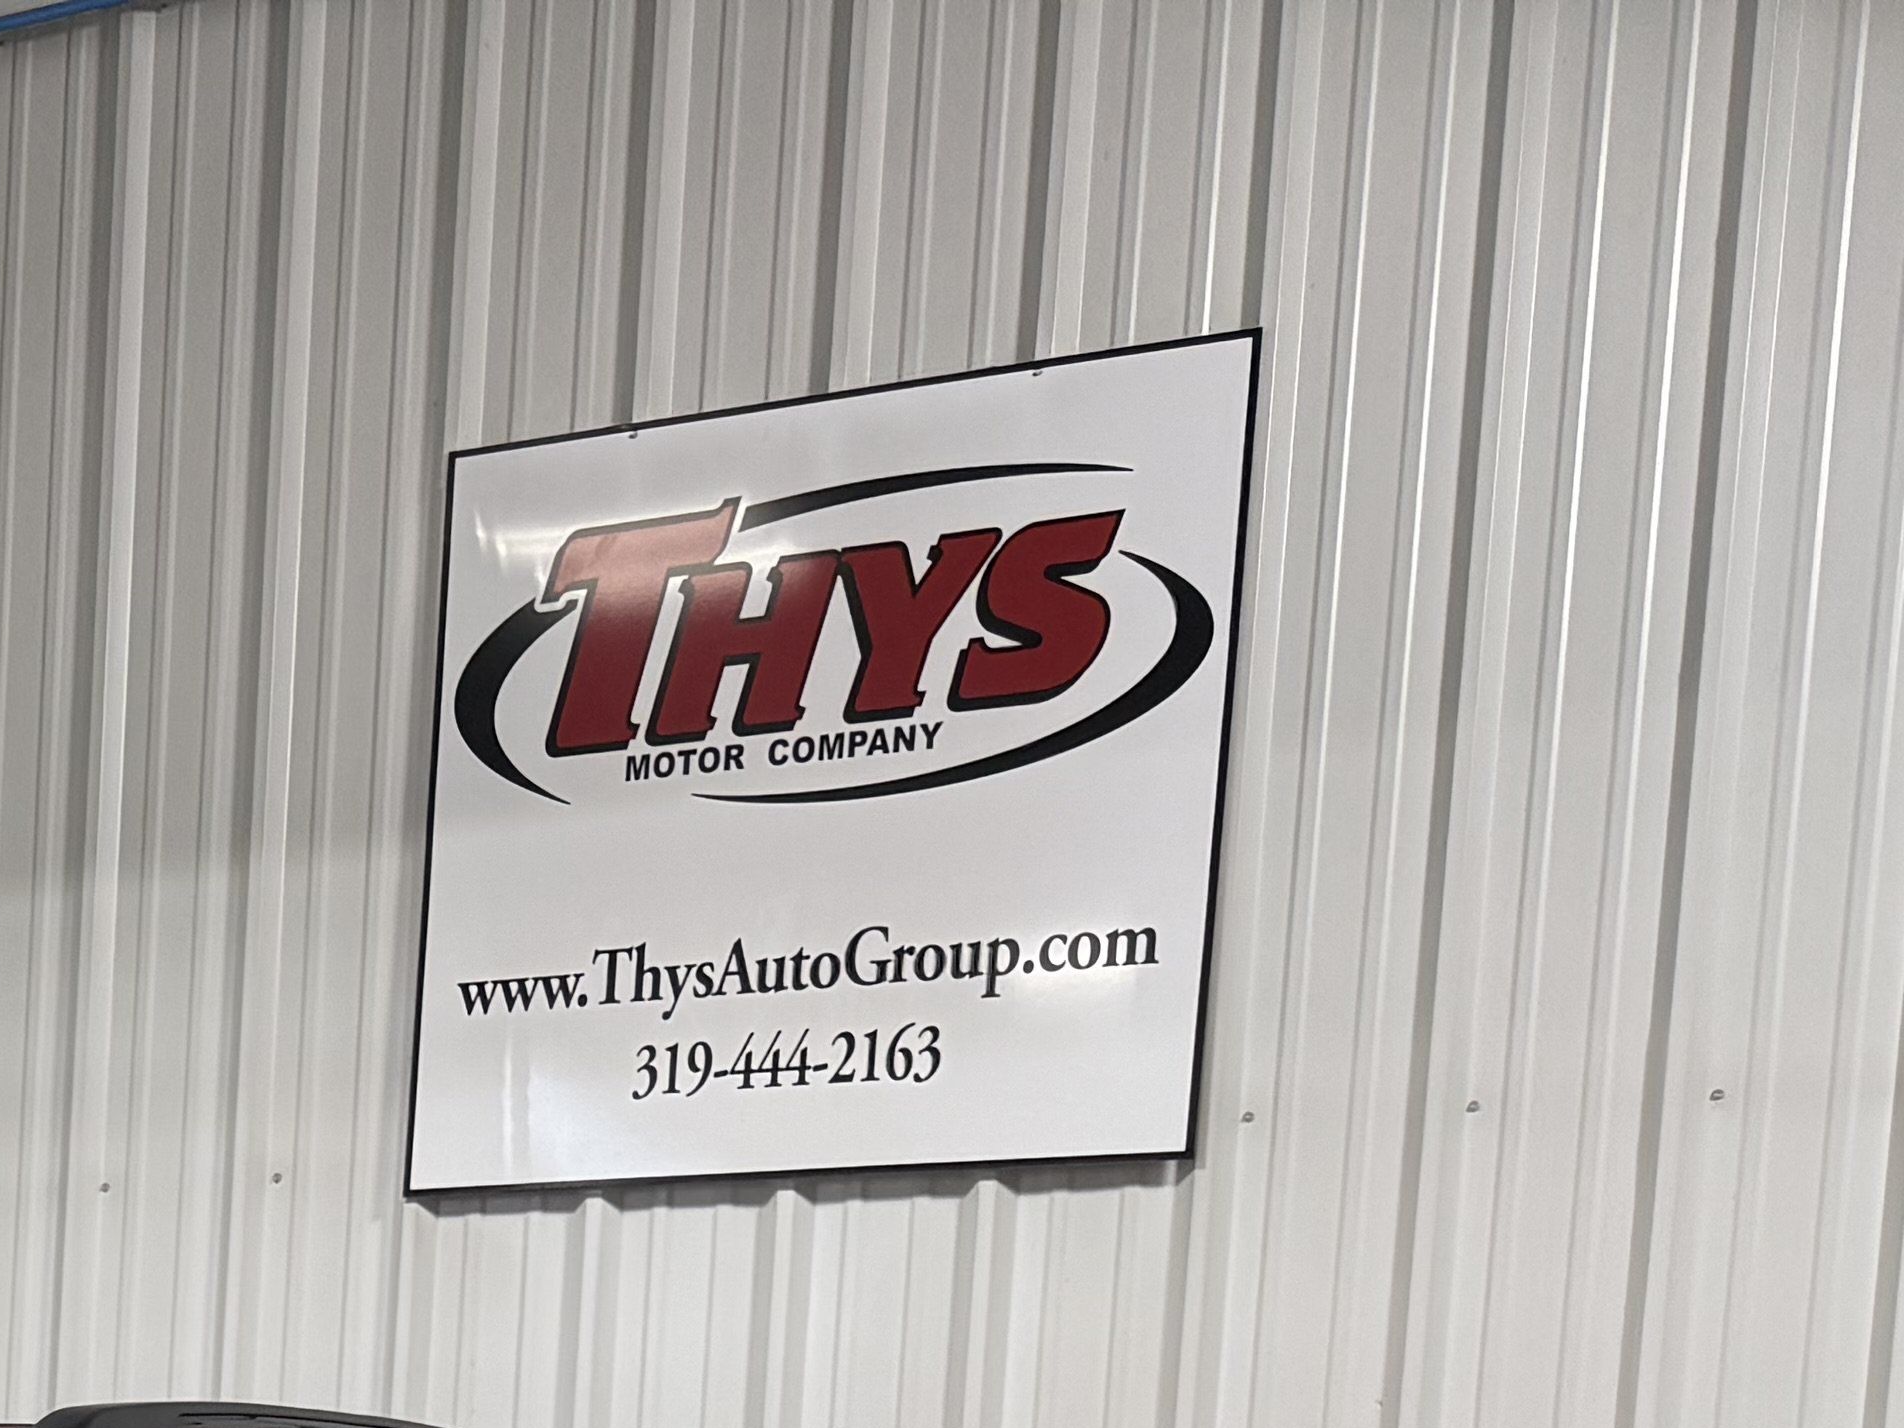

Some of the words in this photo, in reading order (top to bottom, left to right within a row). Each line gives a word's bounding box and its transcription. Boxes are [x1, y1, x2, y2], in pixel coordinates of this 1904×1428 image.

[537, 496, 1126, 758] THYS
[624, 742, 746, 783] MOTOR
[767, 720, 944, 768] COMPANY
[457, 922, 1160, 1019] www.ThysAutoGroup.com
[632, 1022, 944, 1101] 319-444-2163
